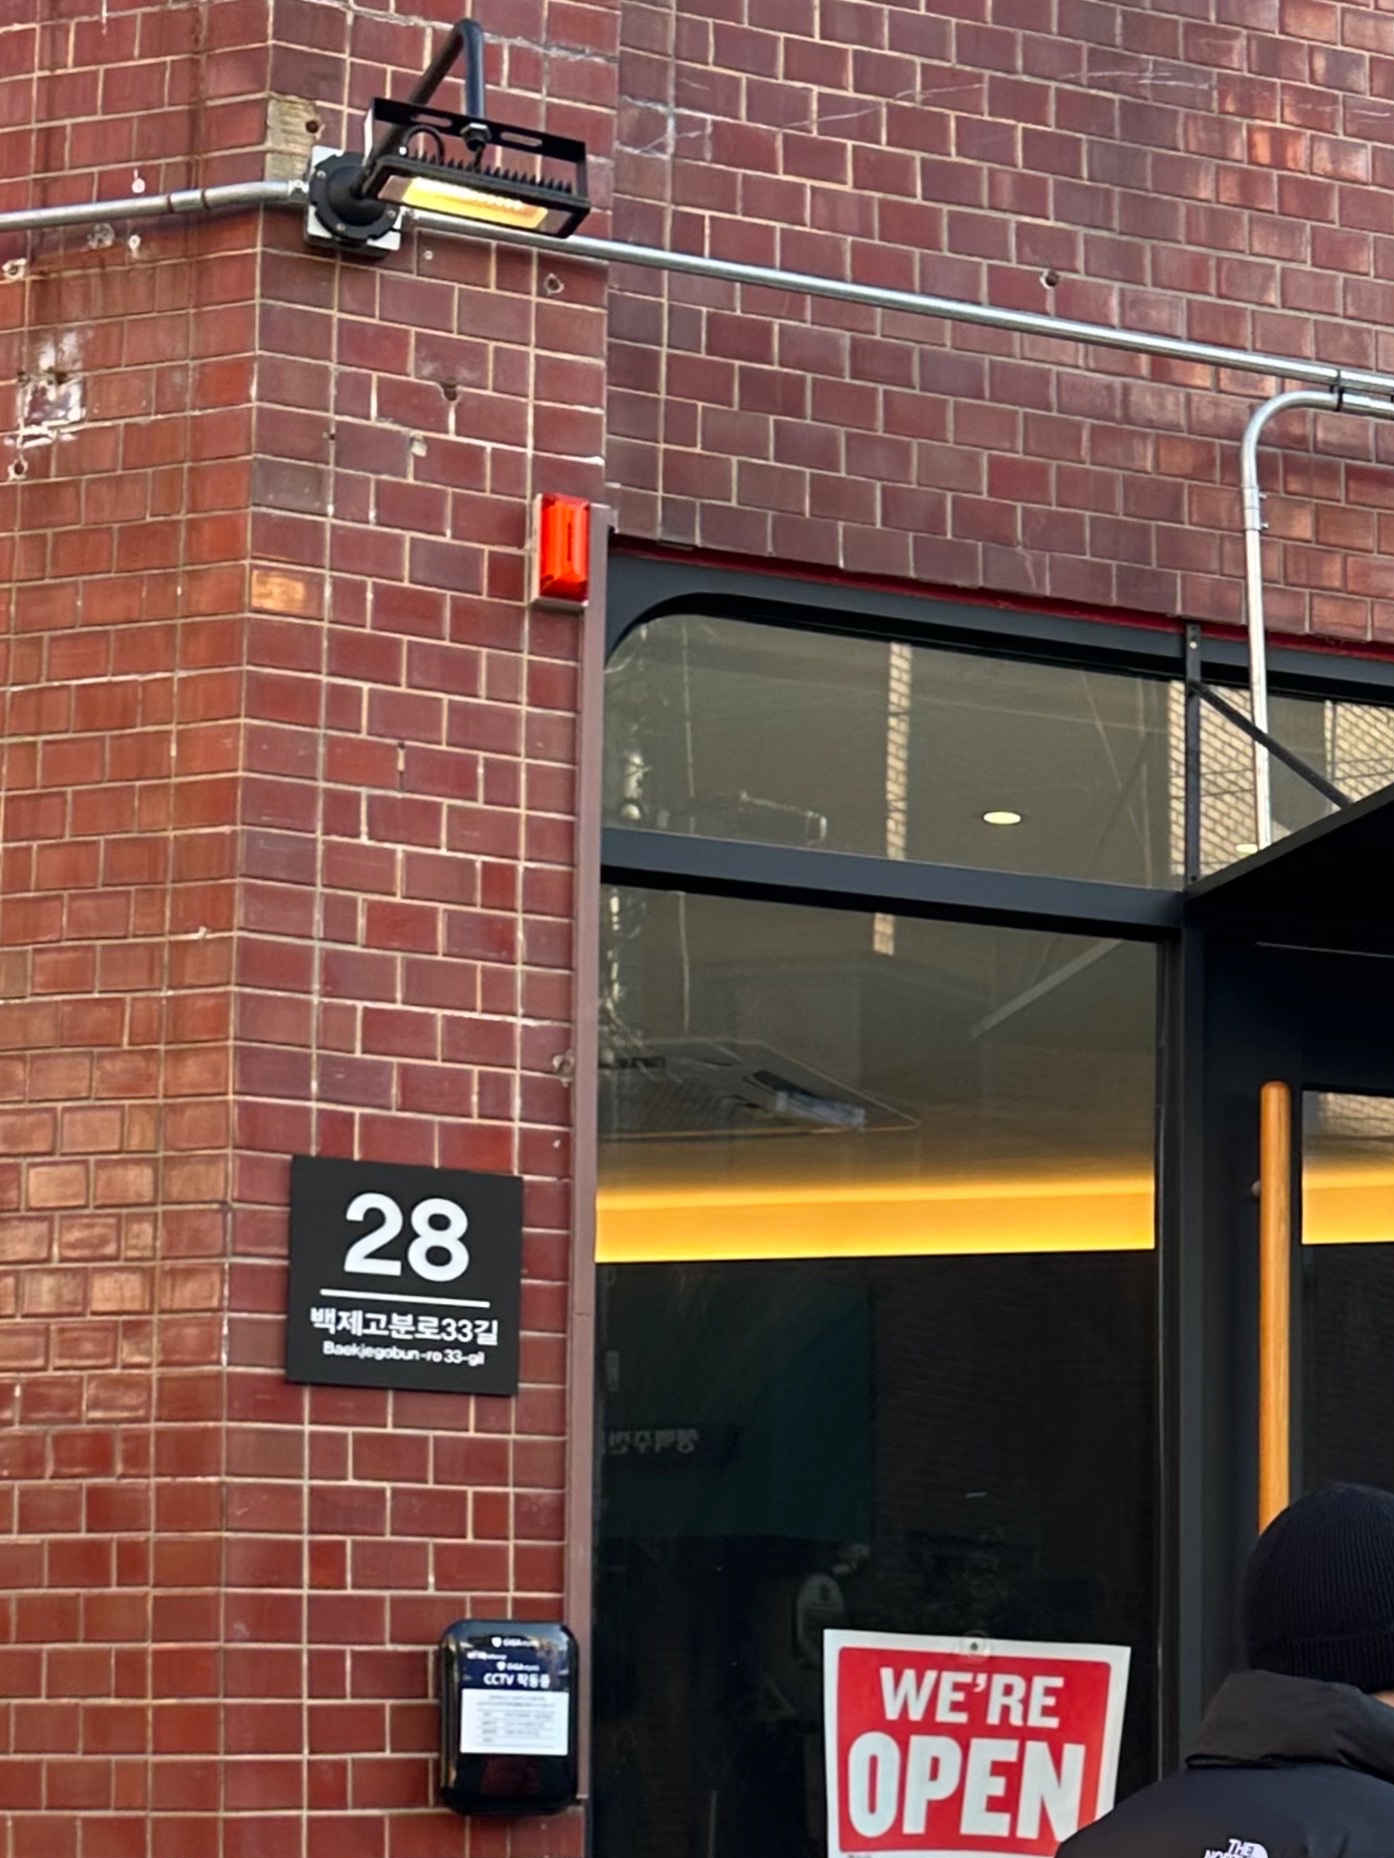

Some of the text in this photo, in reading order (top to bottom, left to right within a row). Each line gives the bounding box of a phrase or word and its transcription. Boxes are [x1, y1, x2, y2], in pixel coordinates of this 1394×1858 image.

[344, 1192, 470, 1282] 28
[309, 1307, 498, 1346] 백제고분로33길
[322, 1340, 485, 1367] Baekjegobun-ro 33-gil
[483, 1673, 515, 1686] CCTV
[879, 1667, 1065, 1729] WE'RE
[848, 1731, 1086, 1843] OPEN
